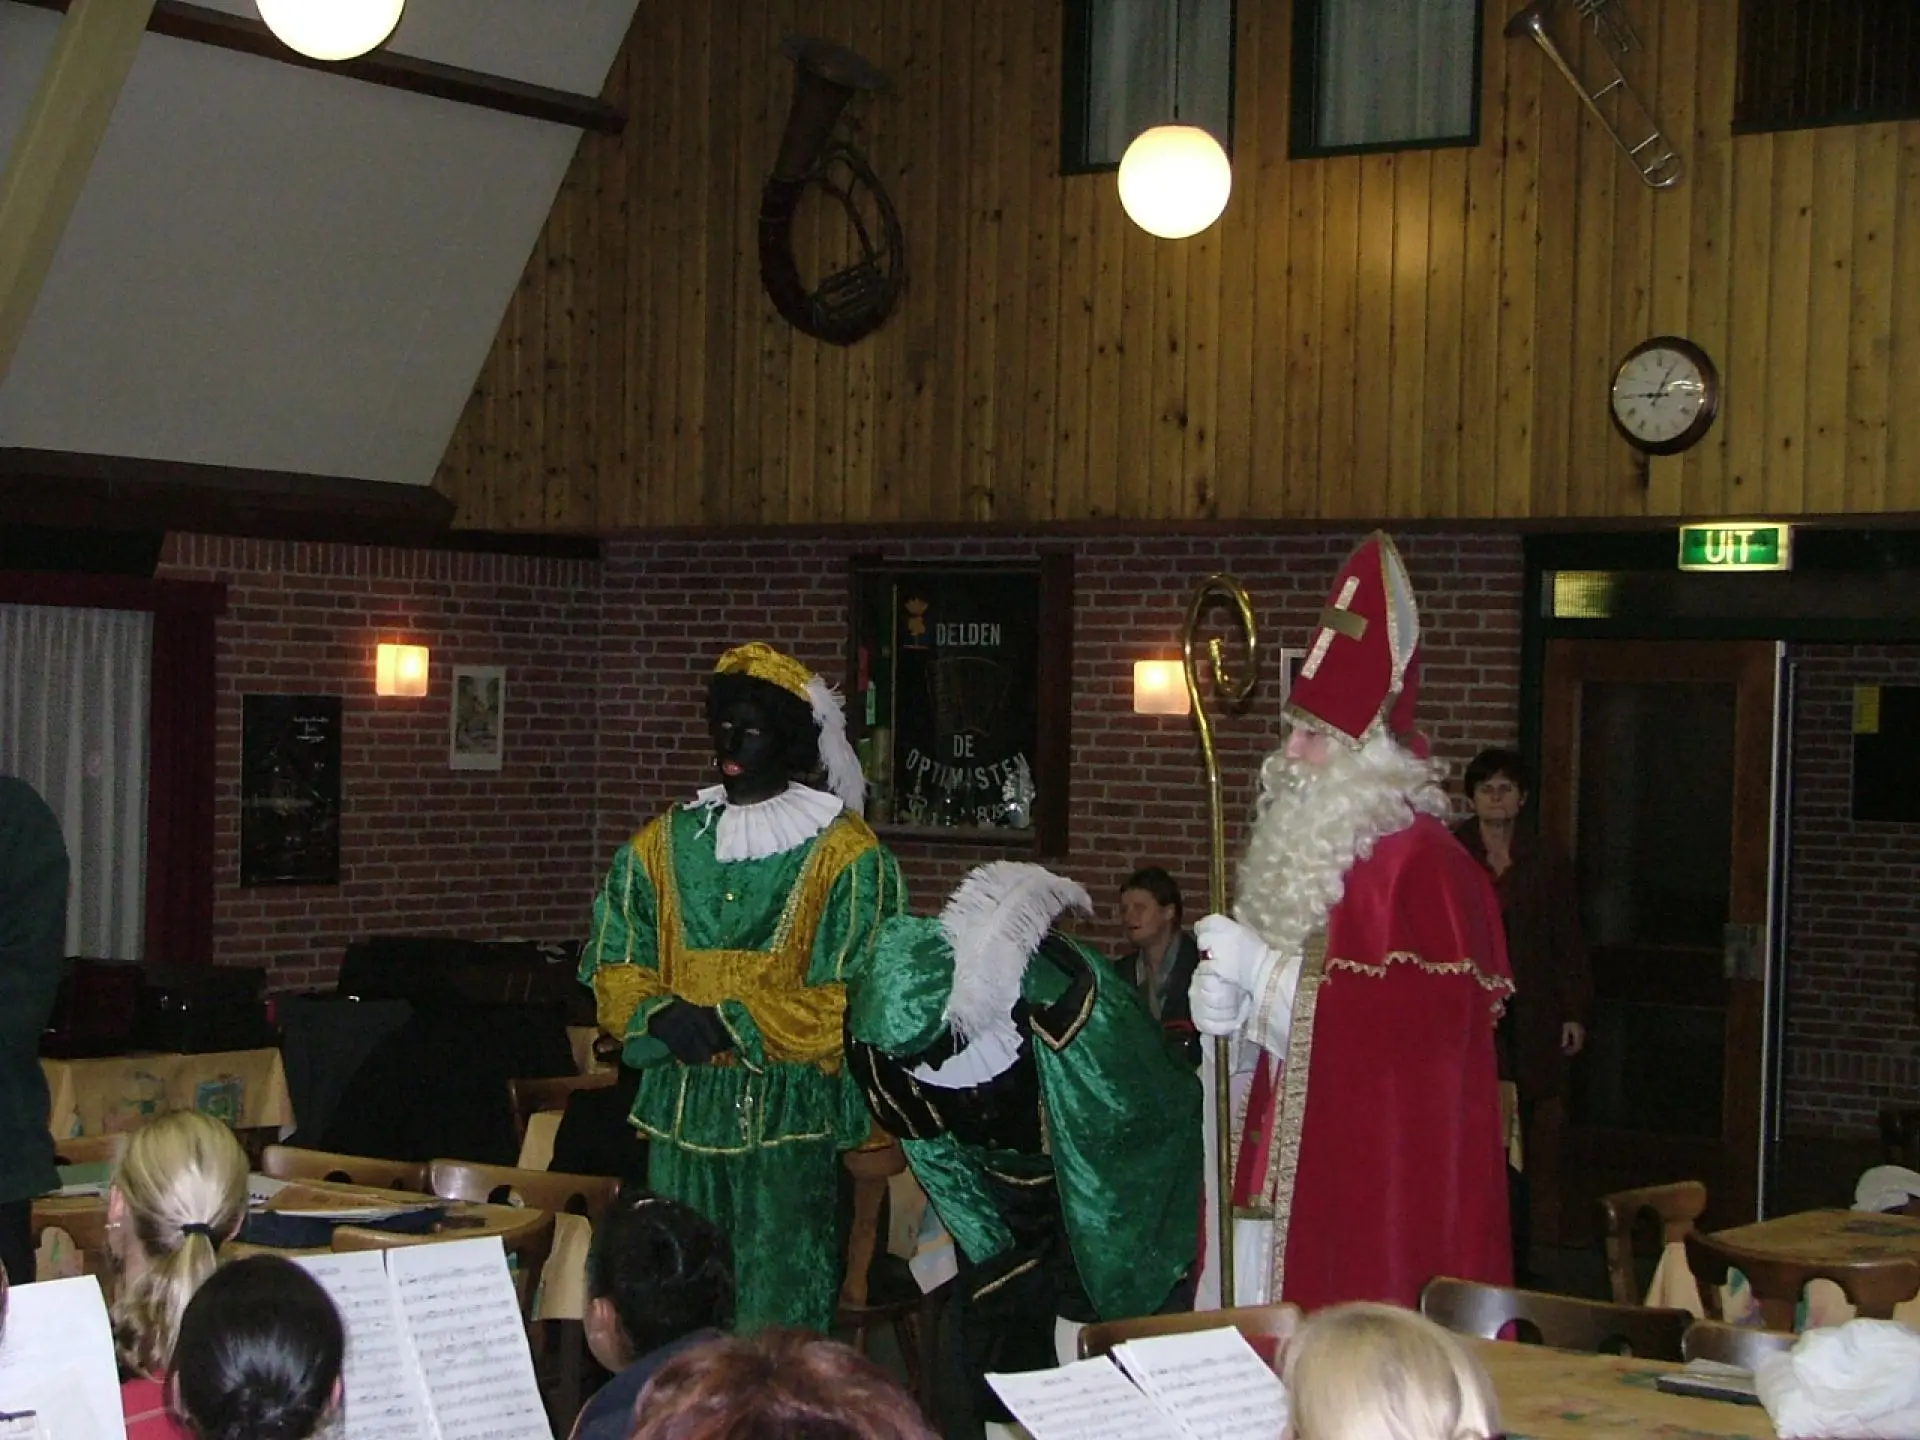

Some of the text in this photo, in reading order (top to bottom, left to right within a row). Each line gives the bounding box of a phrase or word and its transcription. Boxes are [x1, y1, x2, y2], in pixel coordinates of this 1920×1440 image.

[1705, 530, 1756, 564] UIT
[935, 622, 1001, 647] DELDEN
[952, 733, 976, 759] DE
